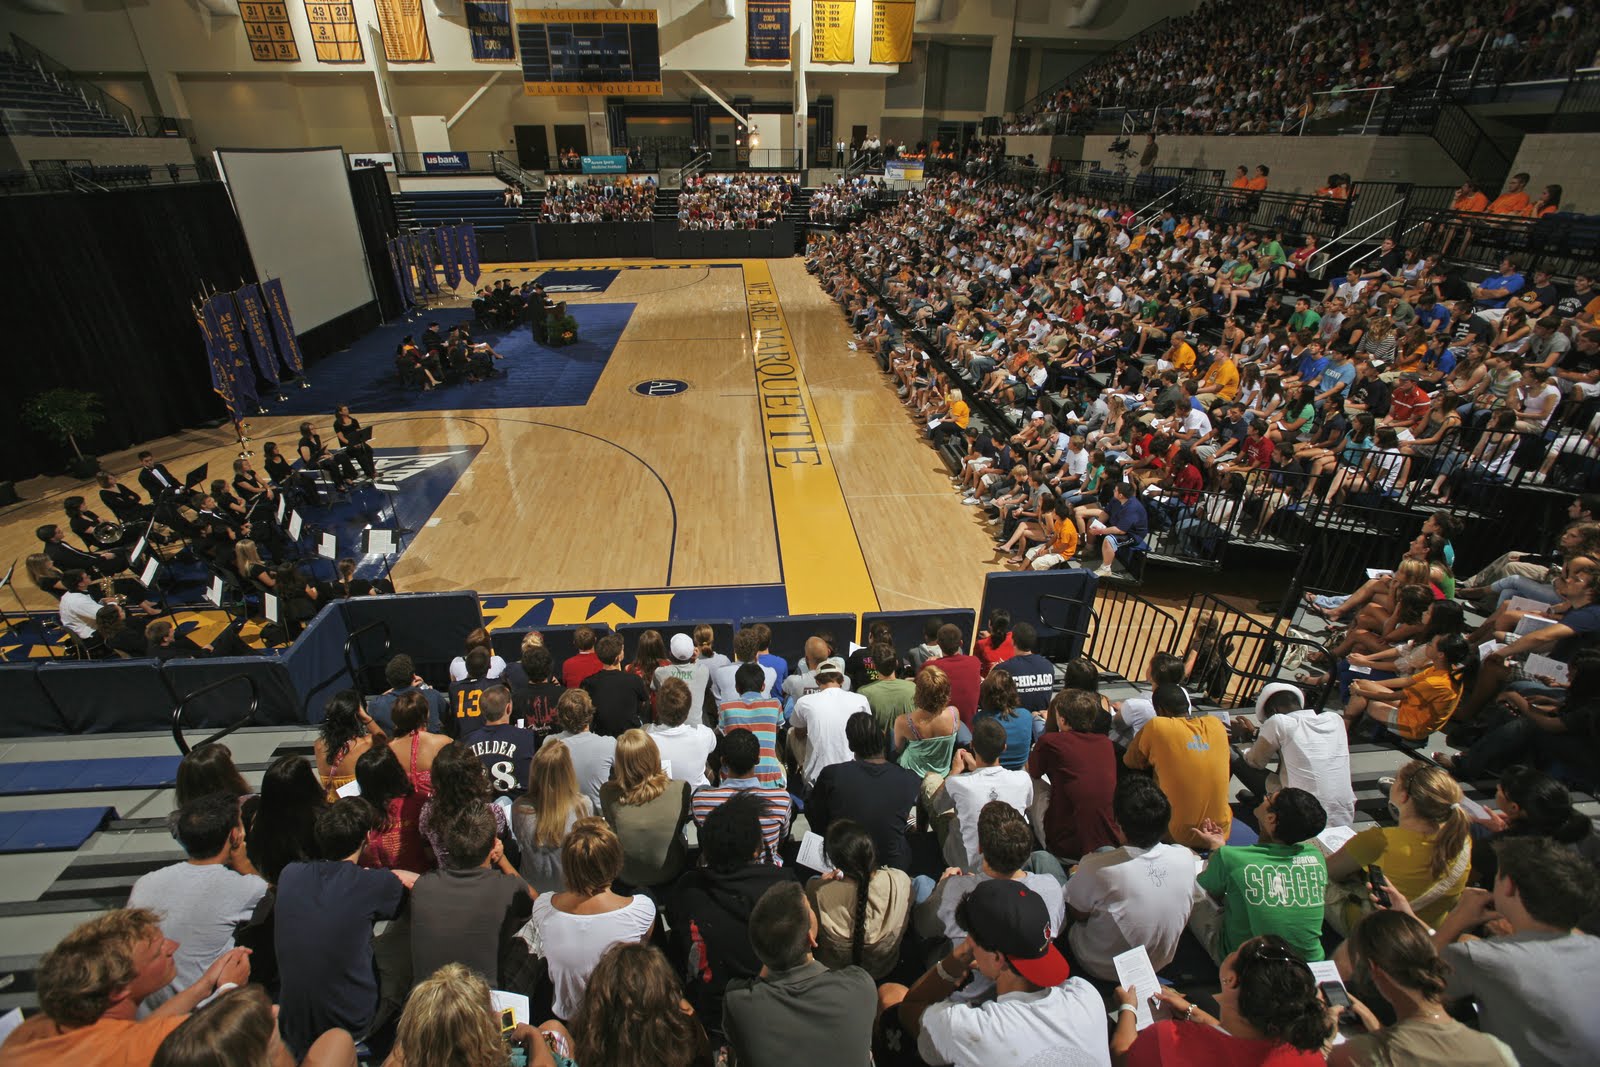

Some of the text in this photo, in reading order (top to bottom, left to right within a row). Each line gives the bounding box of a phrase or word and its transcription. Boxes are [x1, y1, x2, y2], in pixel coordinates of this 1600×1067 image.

[246, 6, 257, 16] 31
[268, 6, 282, 16] 24
[312, 6, 324, 16] 43
[336, 6, 348, 16] 20
[606, 10, 655, 20] CENTER
[252, 26, 262, 34] 14
[274, 26, 285, 34] 15
[320, 26, 326, 36] 3
[257, 44, 270, 54] 44
[280, 45, 290, 54] 31
[577, 84, 662, 94] MARQUETTE
[747, 282, 822, 469] WE ARE MARQUETTE
[1012, 674, 1052, 687] CHICAGO
[456, 689, 482, 718] 13
[469, 740, 517, 758] IELDER
[1244, 864, 1326, 907] SOCCER
